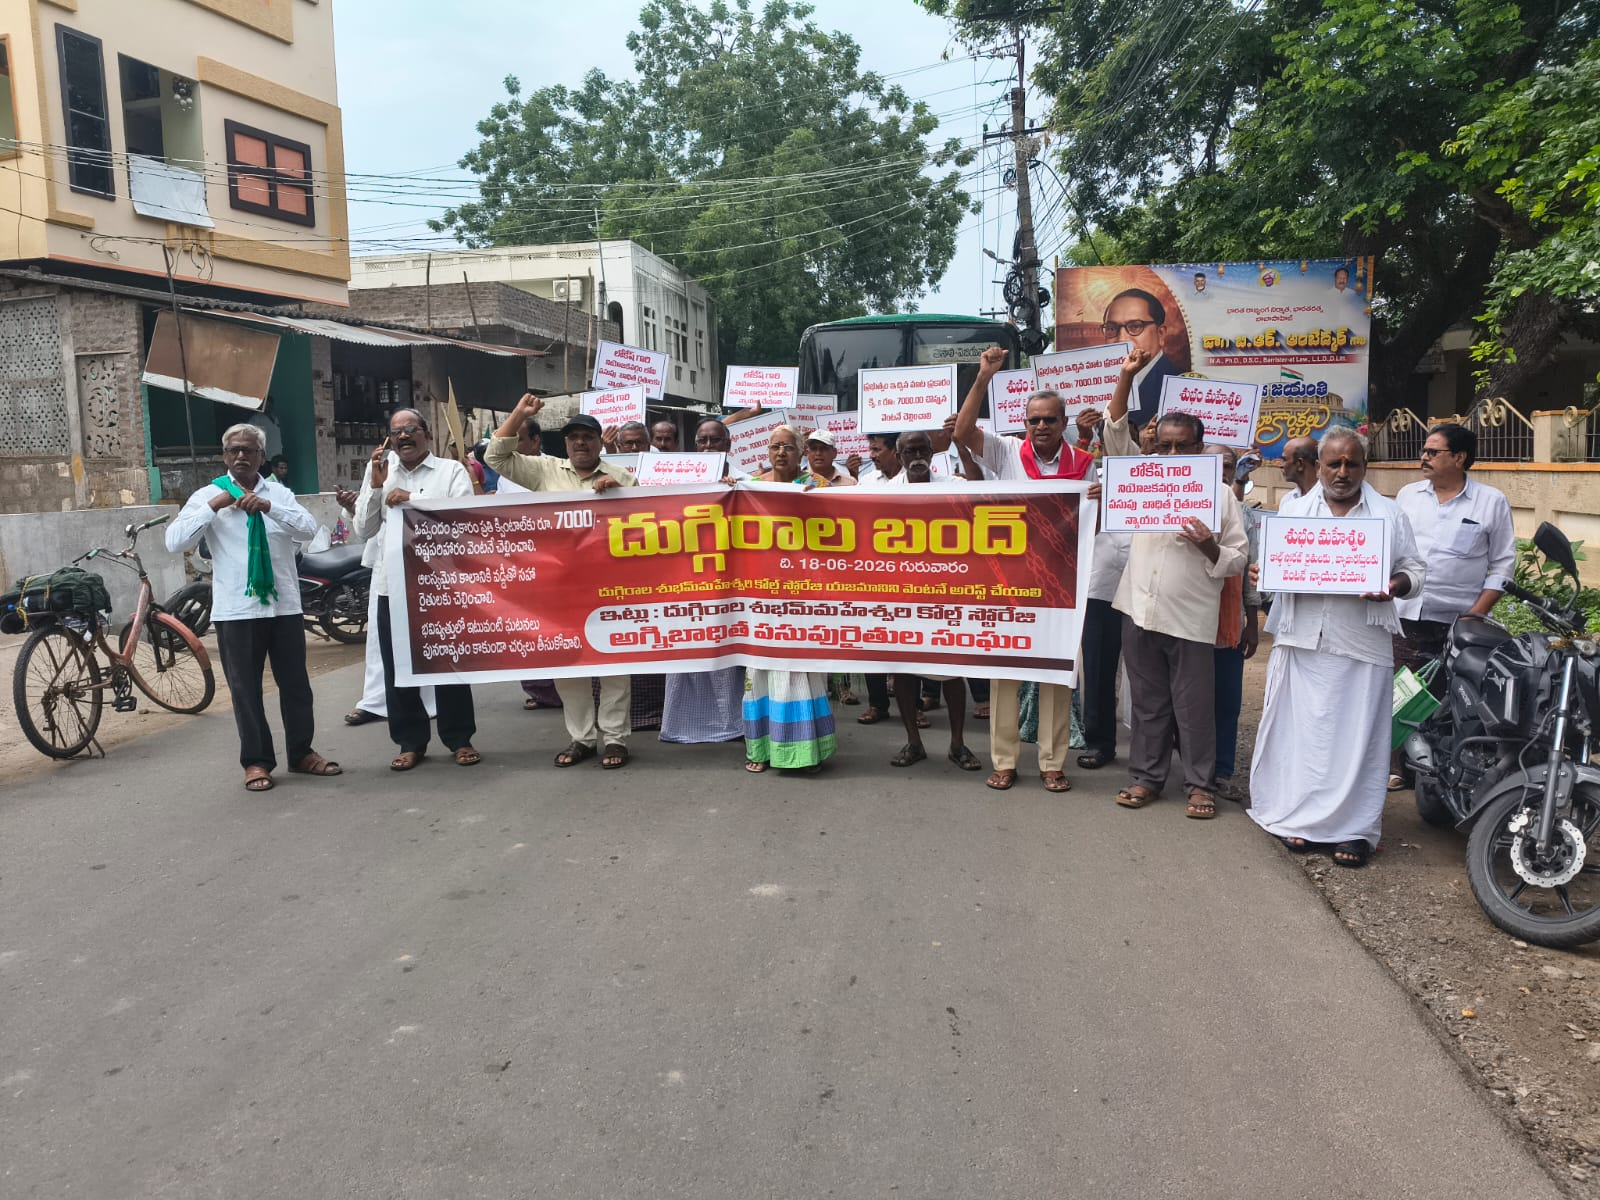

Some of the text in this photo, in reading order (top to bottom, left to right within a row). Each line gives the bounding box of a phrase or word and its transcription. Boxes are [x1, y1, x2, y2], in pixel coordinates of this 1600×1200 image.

[1130, 463, 1191, 478] లోకేష్ గారి
[1109, 498, 1212, 512] పసుపు బాధిత రైతులకు
[414, 523, 450, 540] ఒప్పందం
[451, 520, 479, 539] ప్రకారం
[480, 519, 494, 538] ప్రతి
[554, 509, 601, 531] 7000/-
[1125, 514, 1159, 528] న్యాయం
[607, 504, 1028, 572] దుగ్గిరాల బంద్
[1285, 528, 1315, 548] శుభం
[415, 537, 536, 563] నష్టపరిహారం వెంటనే చెల్లించాలి.
[459, 567, 491, 584] కాలానికి
[518, 567, 536, 582] సహా
[800, 558, 896, 572] 18-06-2026
[900, 560, 969, 574] గురువారం
[598, 585, 653, 600] దుగ్గిరాల
[755, 578, 780, 595] కోల్డ్
[903, 582, 947, 595] వెంటనే
[950, 584, 987, 600] అరెస్ట్
[991, 583, 1042, 598] చేయాలి
[418, 591, 495, 612] రైతులకు చెల్లించాలి.
[663, 601, 745, 622] దుగ్గిరాల
[917, 604, 962, 626] కోల్డ్
[968, 606, 1036, 627] స్టోరేజి
[421, 616, 540, 640] భవిష్యత్తులో ఇటువంటి ఘటనలు
[610, 621, 750, 649] అగ్నిబాధిత
[931, 629, 1032, 651] సంఘం
[423, 632, 583, 663] పునరావృతం కాకుండా చర్యలు తీసుకోవాలి.
